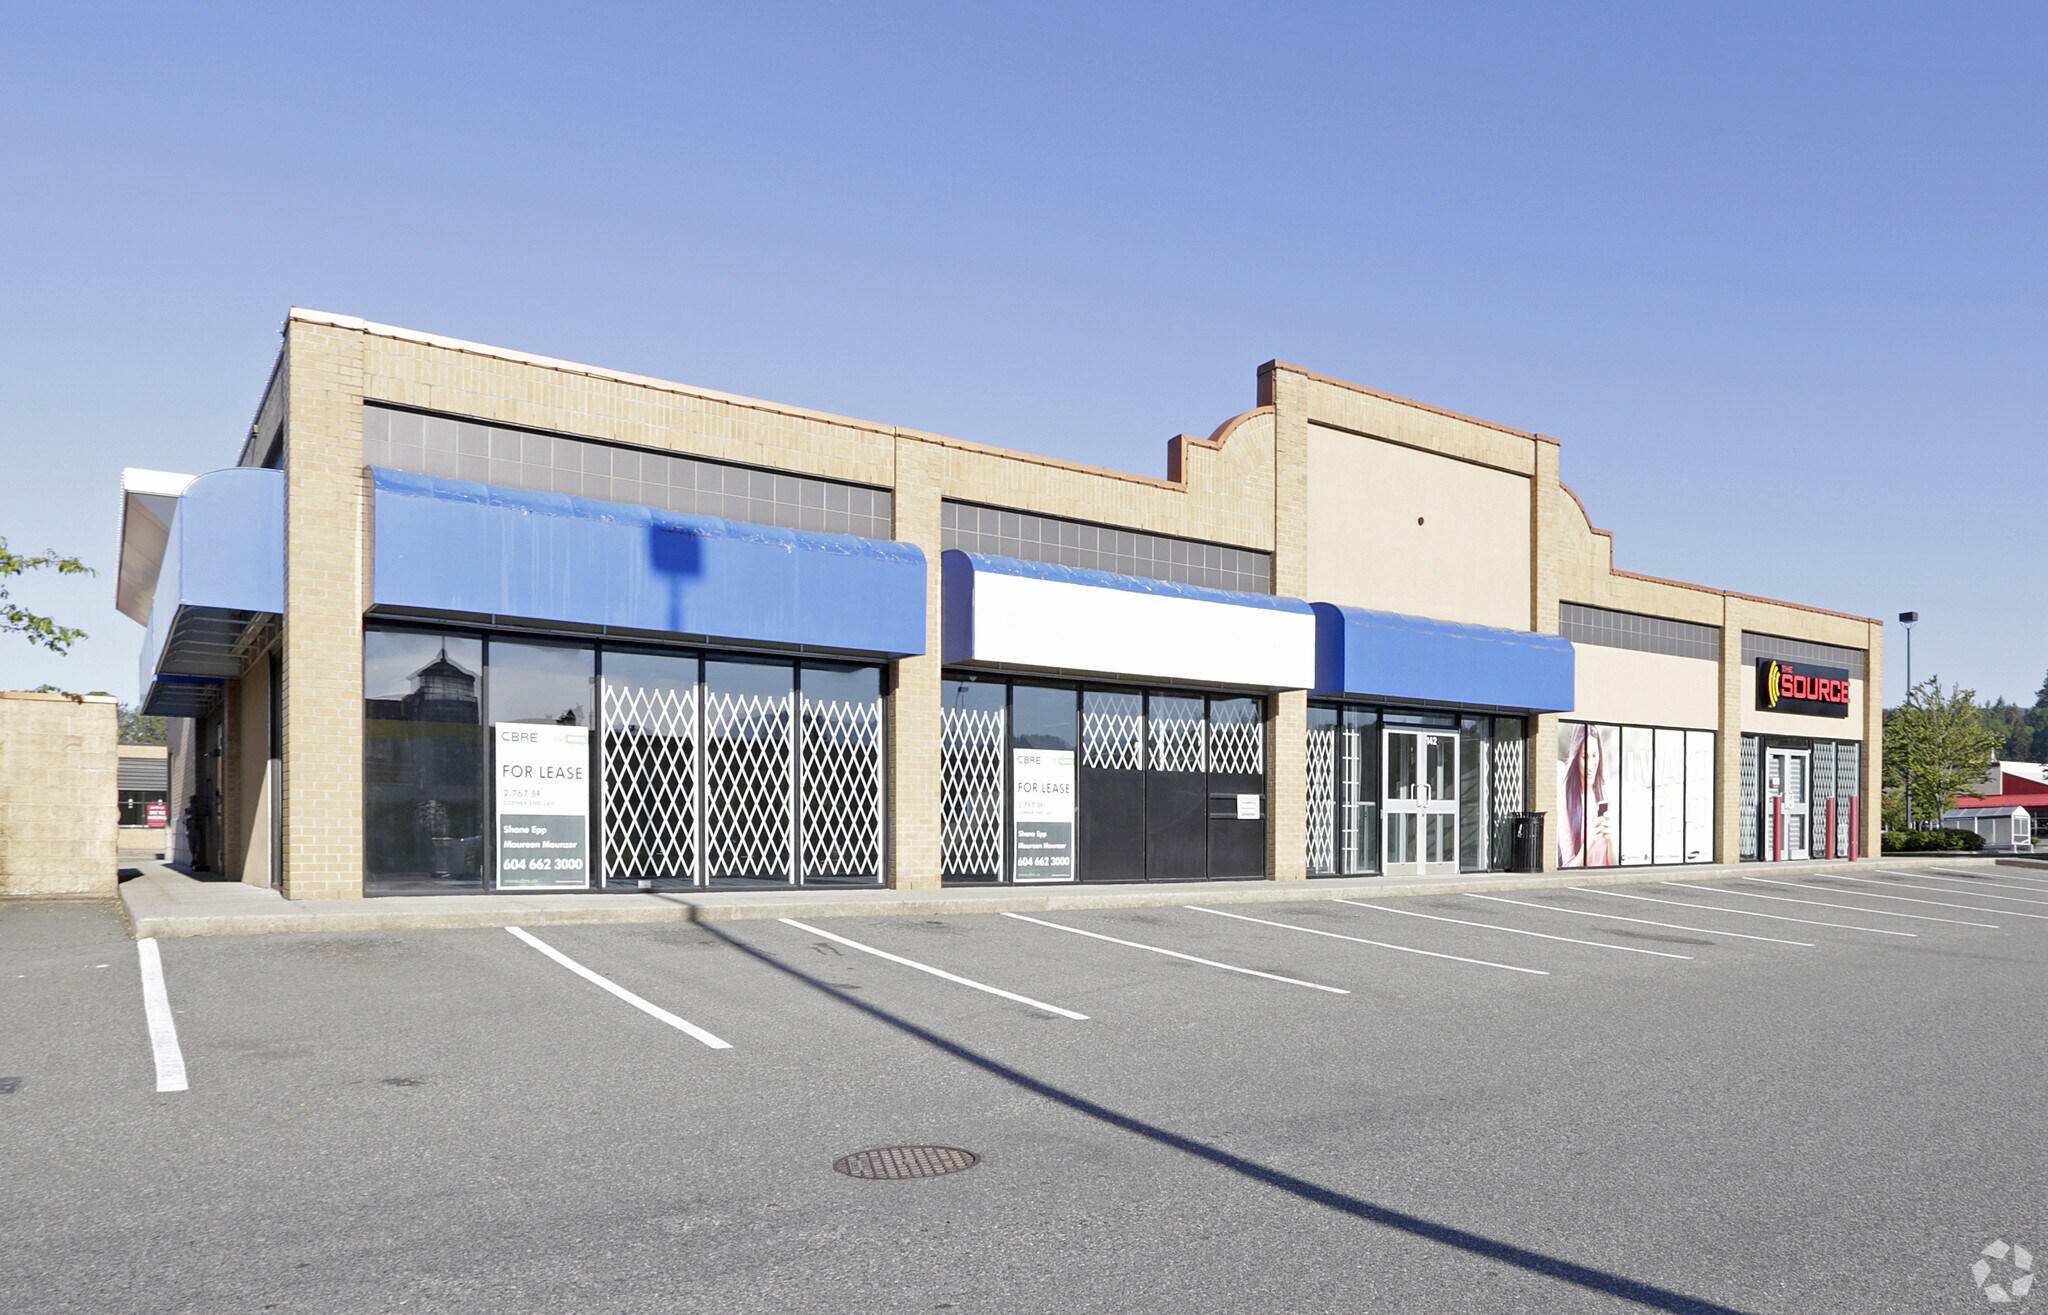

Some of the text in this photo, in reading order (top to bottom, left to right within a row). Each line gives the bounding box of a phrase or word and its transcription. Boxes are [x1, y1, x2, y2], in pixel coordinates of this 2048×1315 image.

[1781, 665, 1793, 674] THE
[1781, 674, 1850, 703] SOURCE
[502, 731, 538, 743] CBRE
[1017, 755, 1041, 765] CBRE
[503, 765, 583, 780] FOR LEASE
[1018, 782, 1070, 794] FOR LEASE
[503, 824, 548, 836] Shane Epp
[503, 840, 541, 849] Maureen
[503, 858, 583, 871] 604 662 3000
[1017, 856, 1070, 867] 604 662 3000
